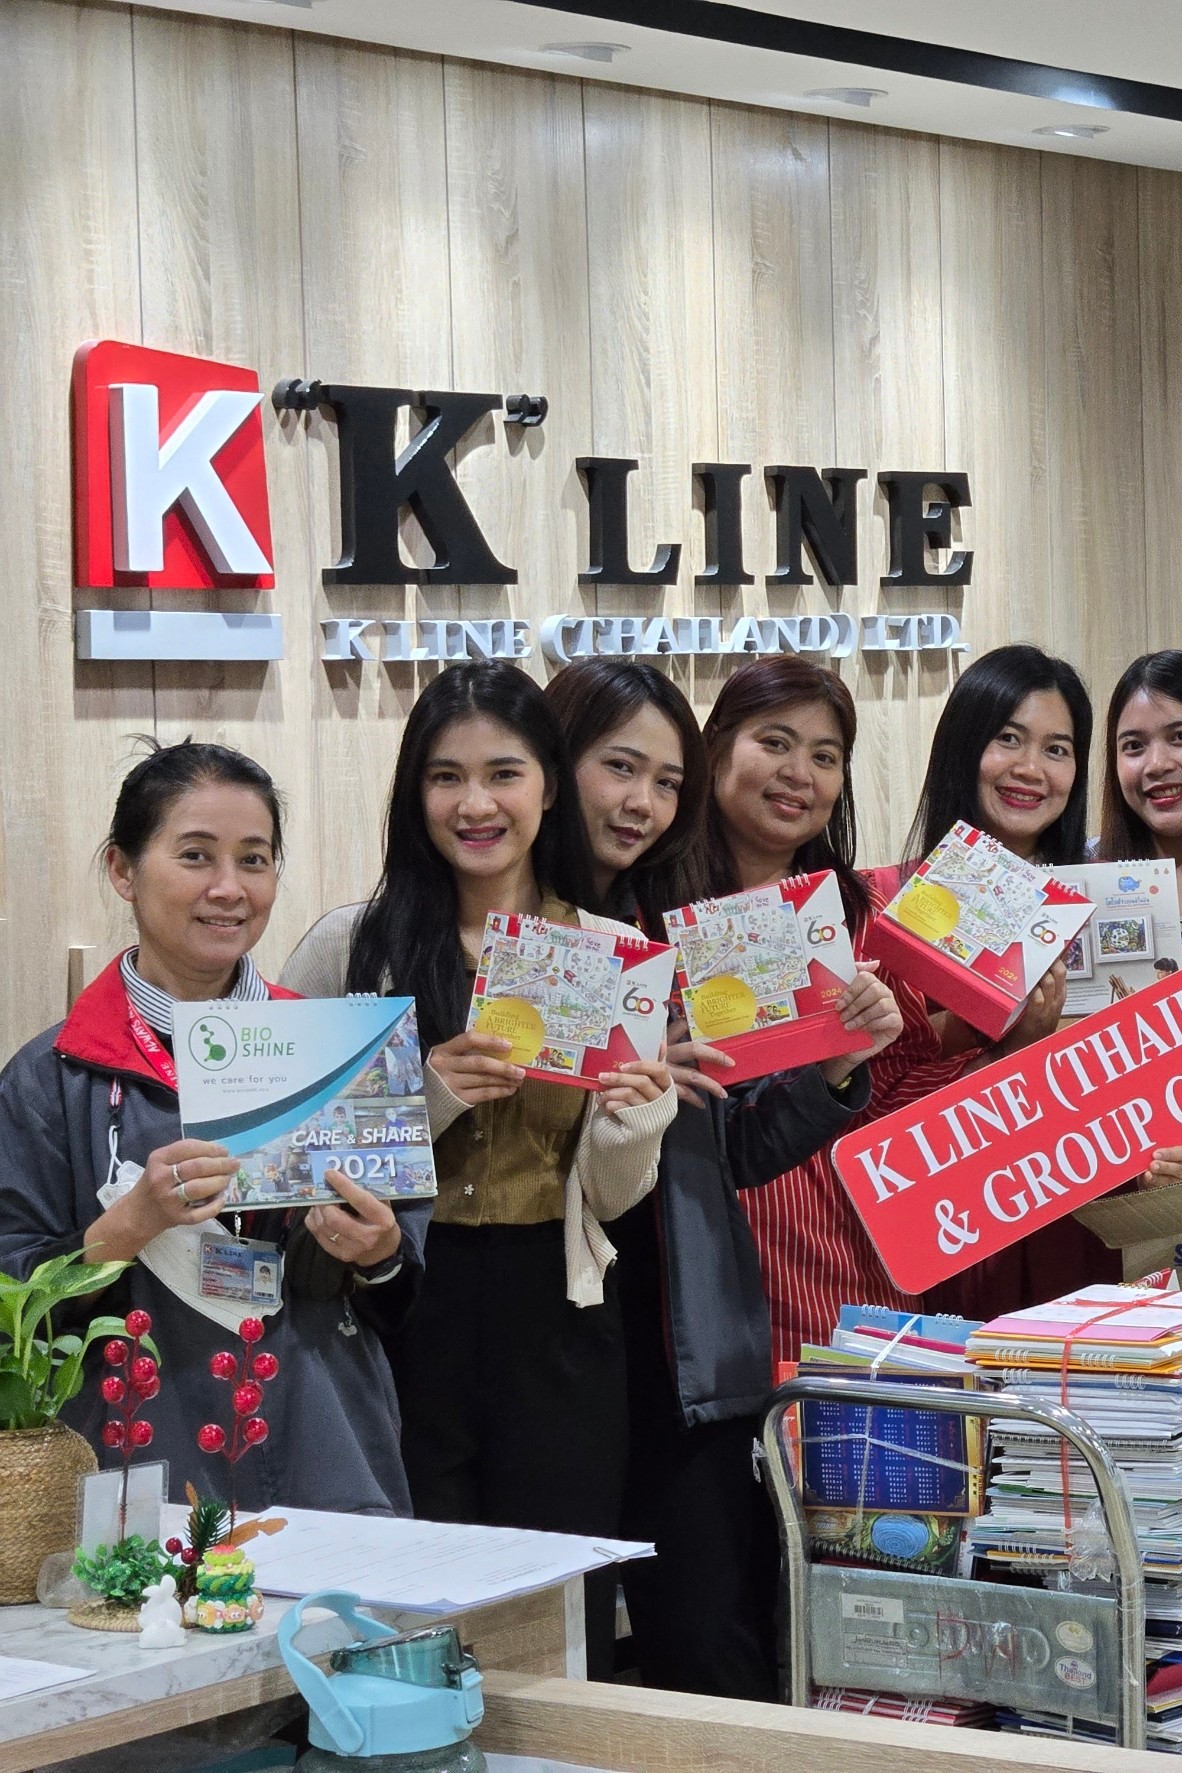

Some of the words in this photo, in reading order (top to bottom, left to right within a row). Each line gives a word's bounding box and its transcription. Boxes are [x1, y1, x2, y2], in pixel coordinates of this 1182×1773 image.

[108, 382, 273, 576] K
[576, 456, 974, 587] LINE
[321, 618, 375, 662] K
[378, 618, 533, 662] LINE
[541, 612, 859, 664] (THAILAND)
[861, 615, 972, 654] LTD.
[806, 920, 836, 945] 60
[1030, 919, 1057, 944] 60
[998, 965, 1019, 982] 2024
[622, 987, 655, 1015] 60
[820, 987, 843, 999] 2024
[131, 1020, 160, 1053] ALWAYS
[240, 1026, 272, 1042] BIO
[243, 1042, 295, 1057] SHINE
[203, 1077, 217, 1085] we
[221, 1076, 245, 1085] care
[249, 1075, 264, 1084] for
[267, 1076, 287, 1085] you
[292, 1130, 343, 1147] CARE
[347, 1134, 356, 1145] &
[362, 1126, 424, 1144] SHARE
[854, 1136, 916, 1205] K
[905, 1072, 1044, 1177] LINE
[326, 1153, 397, 1179] 2021
[932, 1197, 981, 1256] &
[982, 1096, 1158, 1226] GROUP
[1059, 1663, 1092, 1681] Thailand
